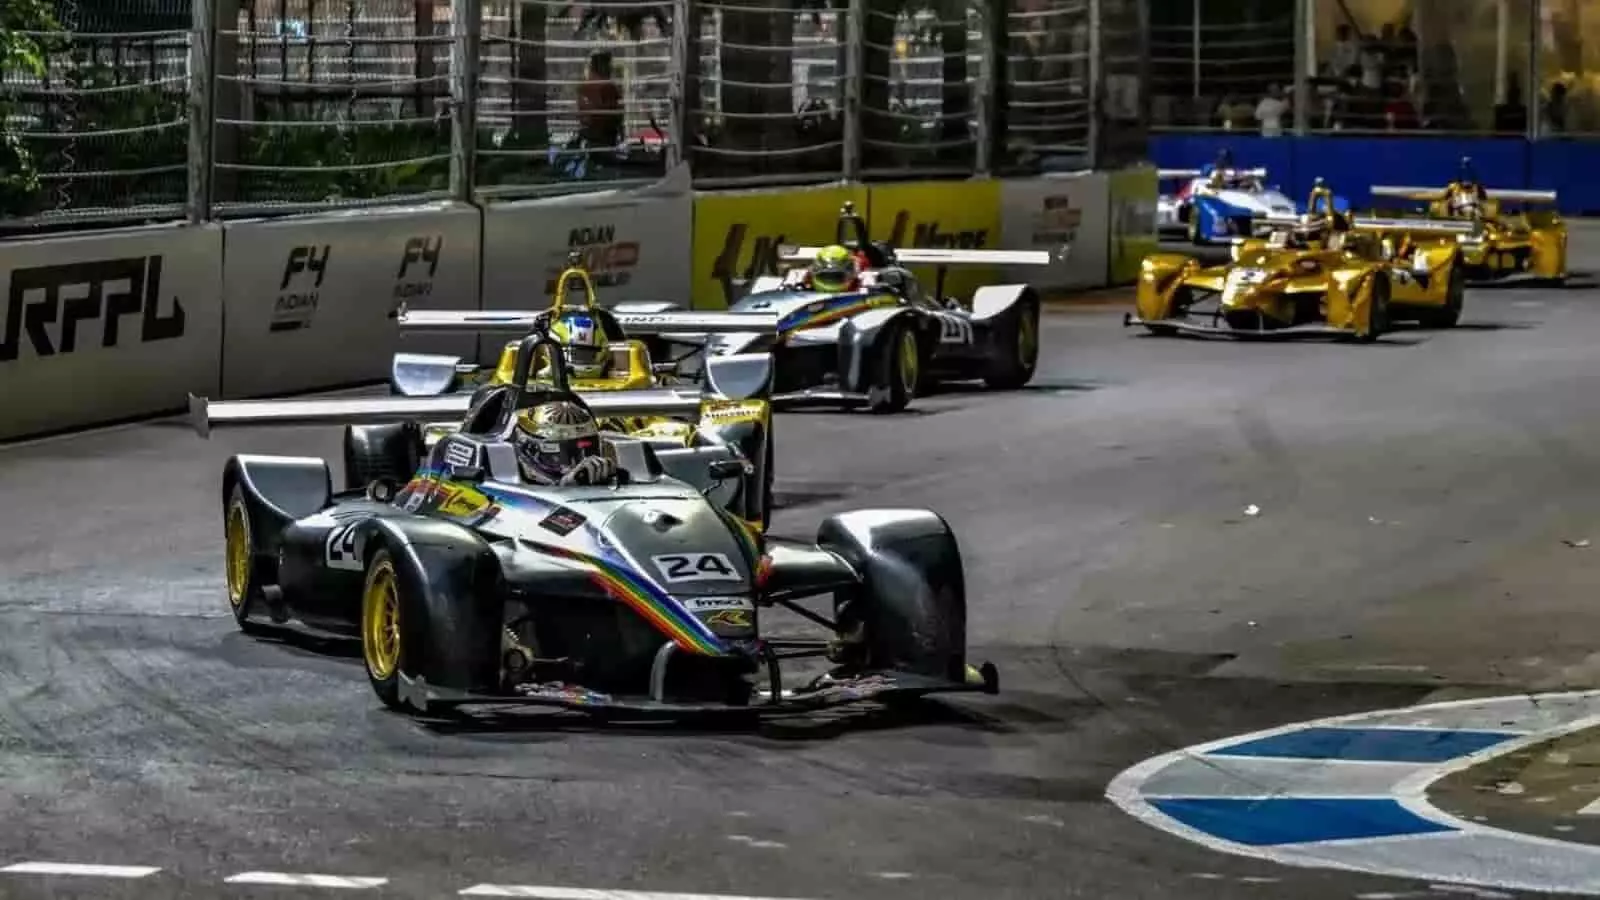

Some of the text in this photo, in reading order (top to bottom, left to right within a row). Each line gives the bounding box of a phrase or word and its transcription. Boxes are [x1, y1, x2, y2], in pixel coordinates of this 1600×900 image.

[279, 245, 331, 291] F4
[398, 235, 442, 279] F4
[0, 255, 186, 361] RPPL
[658, 555, 733, 579] 24
